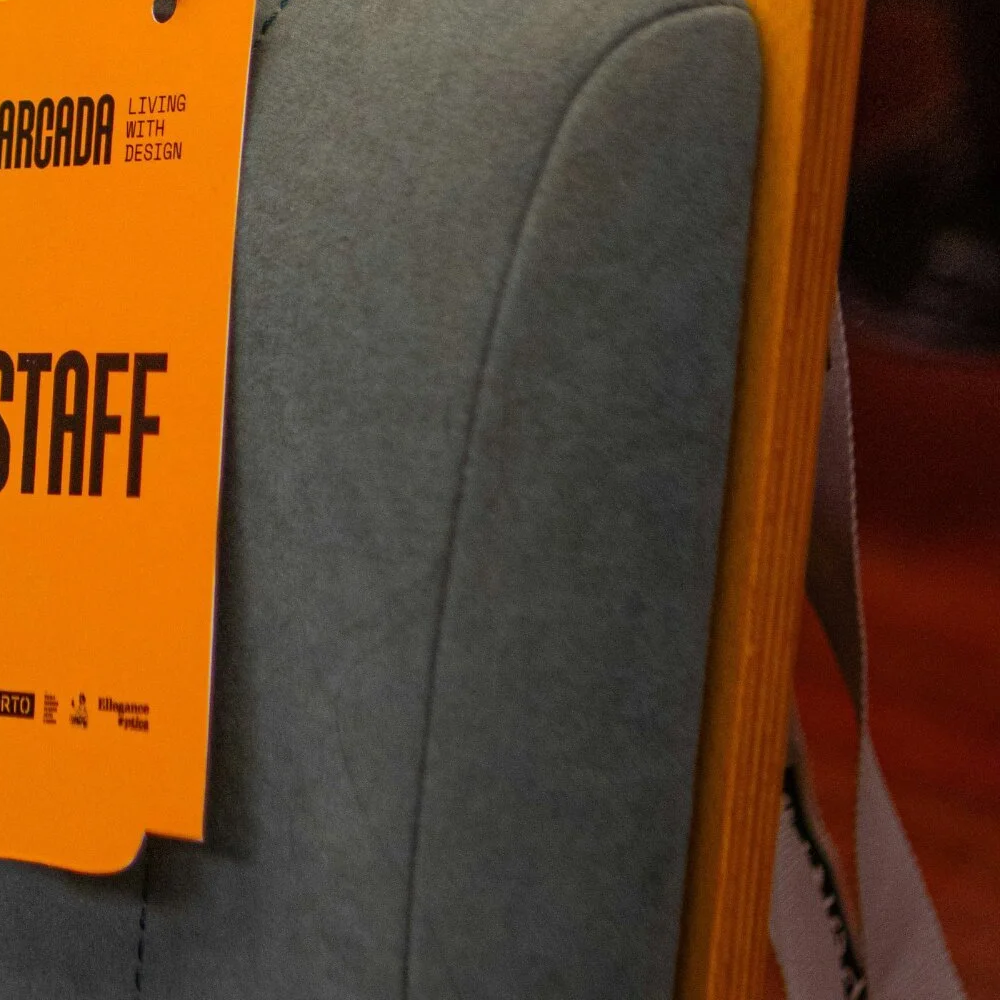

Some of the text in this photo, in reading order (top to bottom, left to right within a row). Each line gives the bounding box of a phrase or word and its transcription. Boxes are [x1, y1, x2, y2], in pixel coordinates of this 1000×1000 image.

[128, 94, 187, 115] LIVING
[125, 119, 165, 138] WITH
[124, 142, 182, 163] DESIGN
